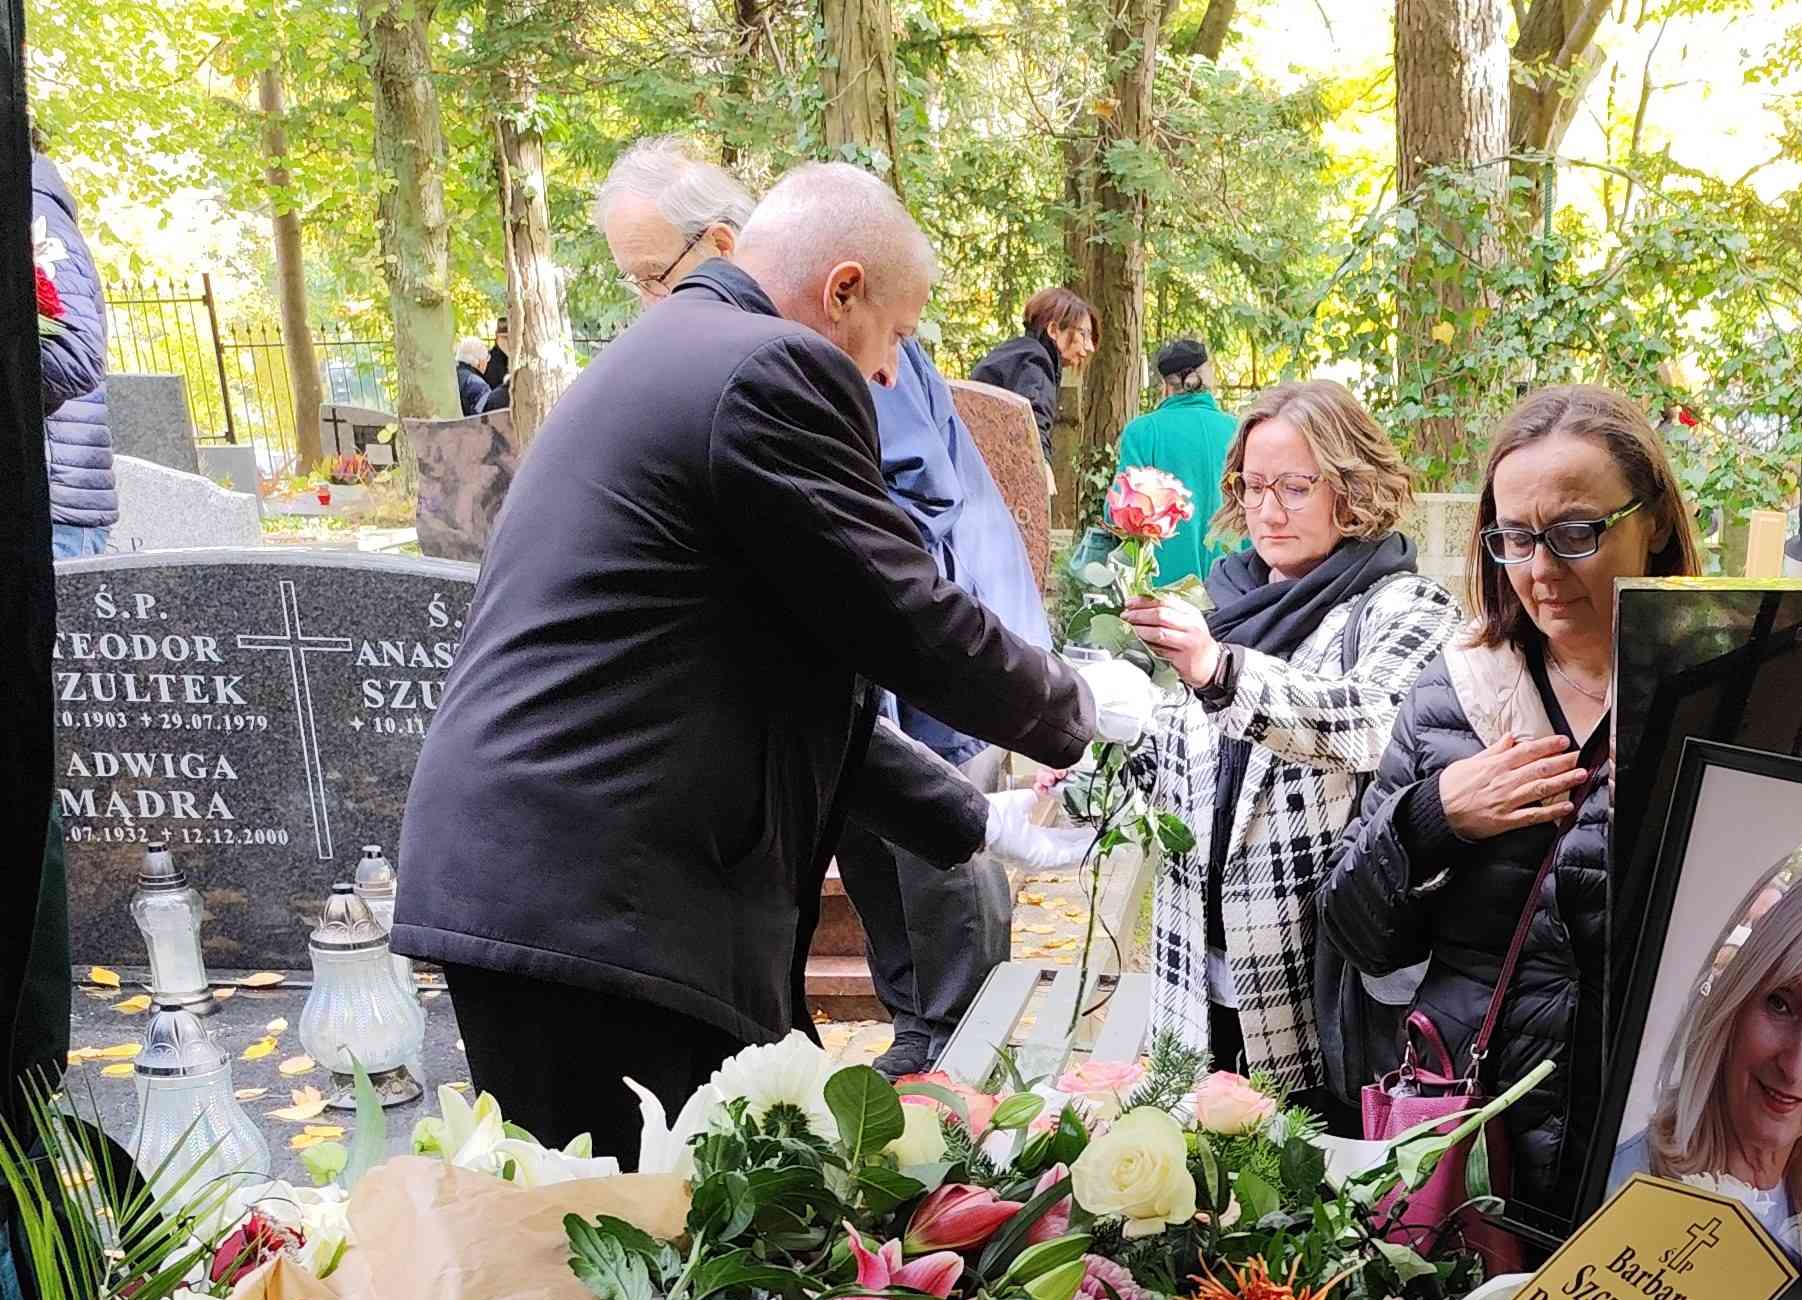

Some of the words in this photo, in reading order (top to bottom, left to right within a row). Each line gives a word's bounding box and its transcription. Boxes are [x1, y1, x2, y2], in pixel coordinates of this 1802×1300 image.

[95, 583, 169, 620] Ś.P.
[428, 592, 472, 628] Ś.
[355, 639, 461, 669] ANAS
[58, 672, 248, 705] ZULTEK
[362, 679, 446, 710] SZU
[62, 711, 128, 729] 0.1903
[161, 713, 268, 731] 29.07.1979
[66, 752, 239, 780] ADWIGA
[57, 788, 235, 827] MĄDRA
[64, 826, 149, 843] .07.1932
[182, 828, 289, 845] 12.12.2000
